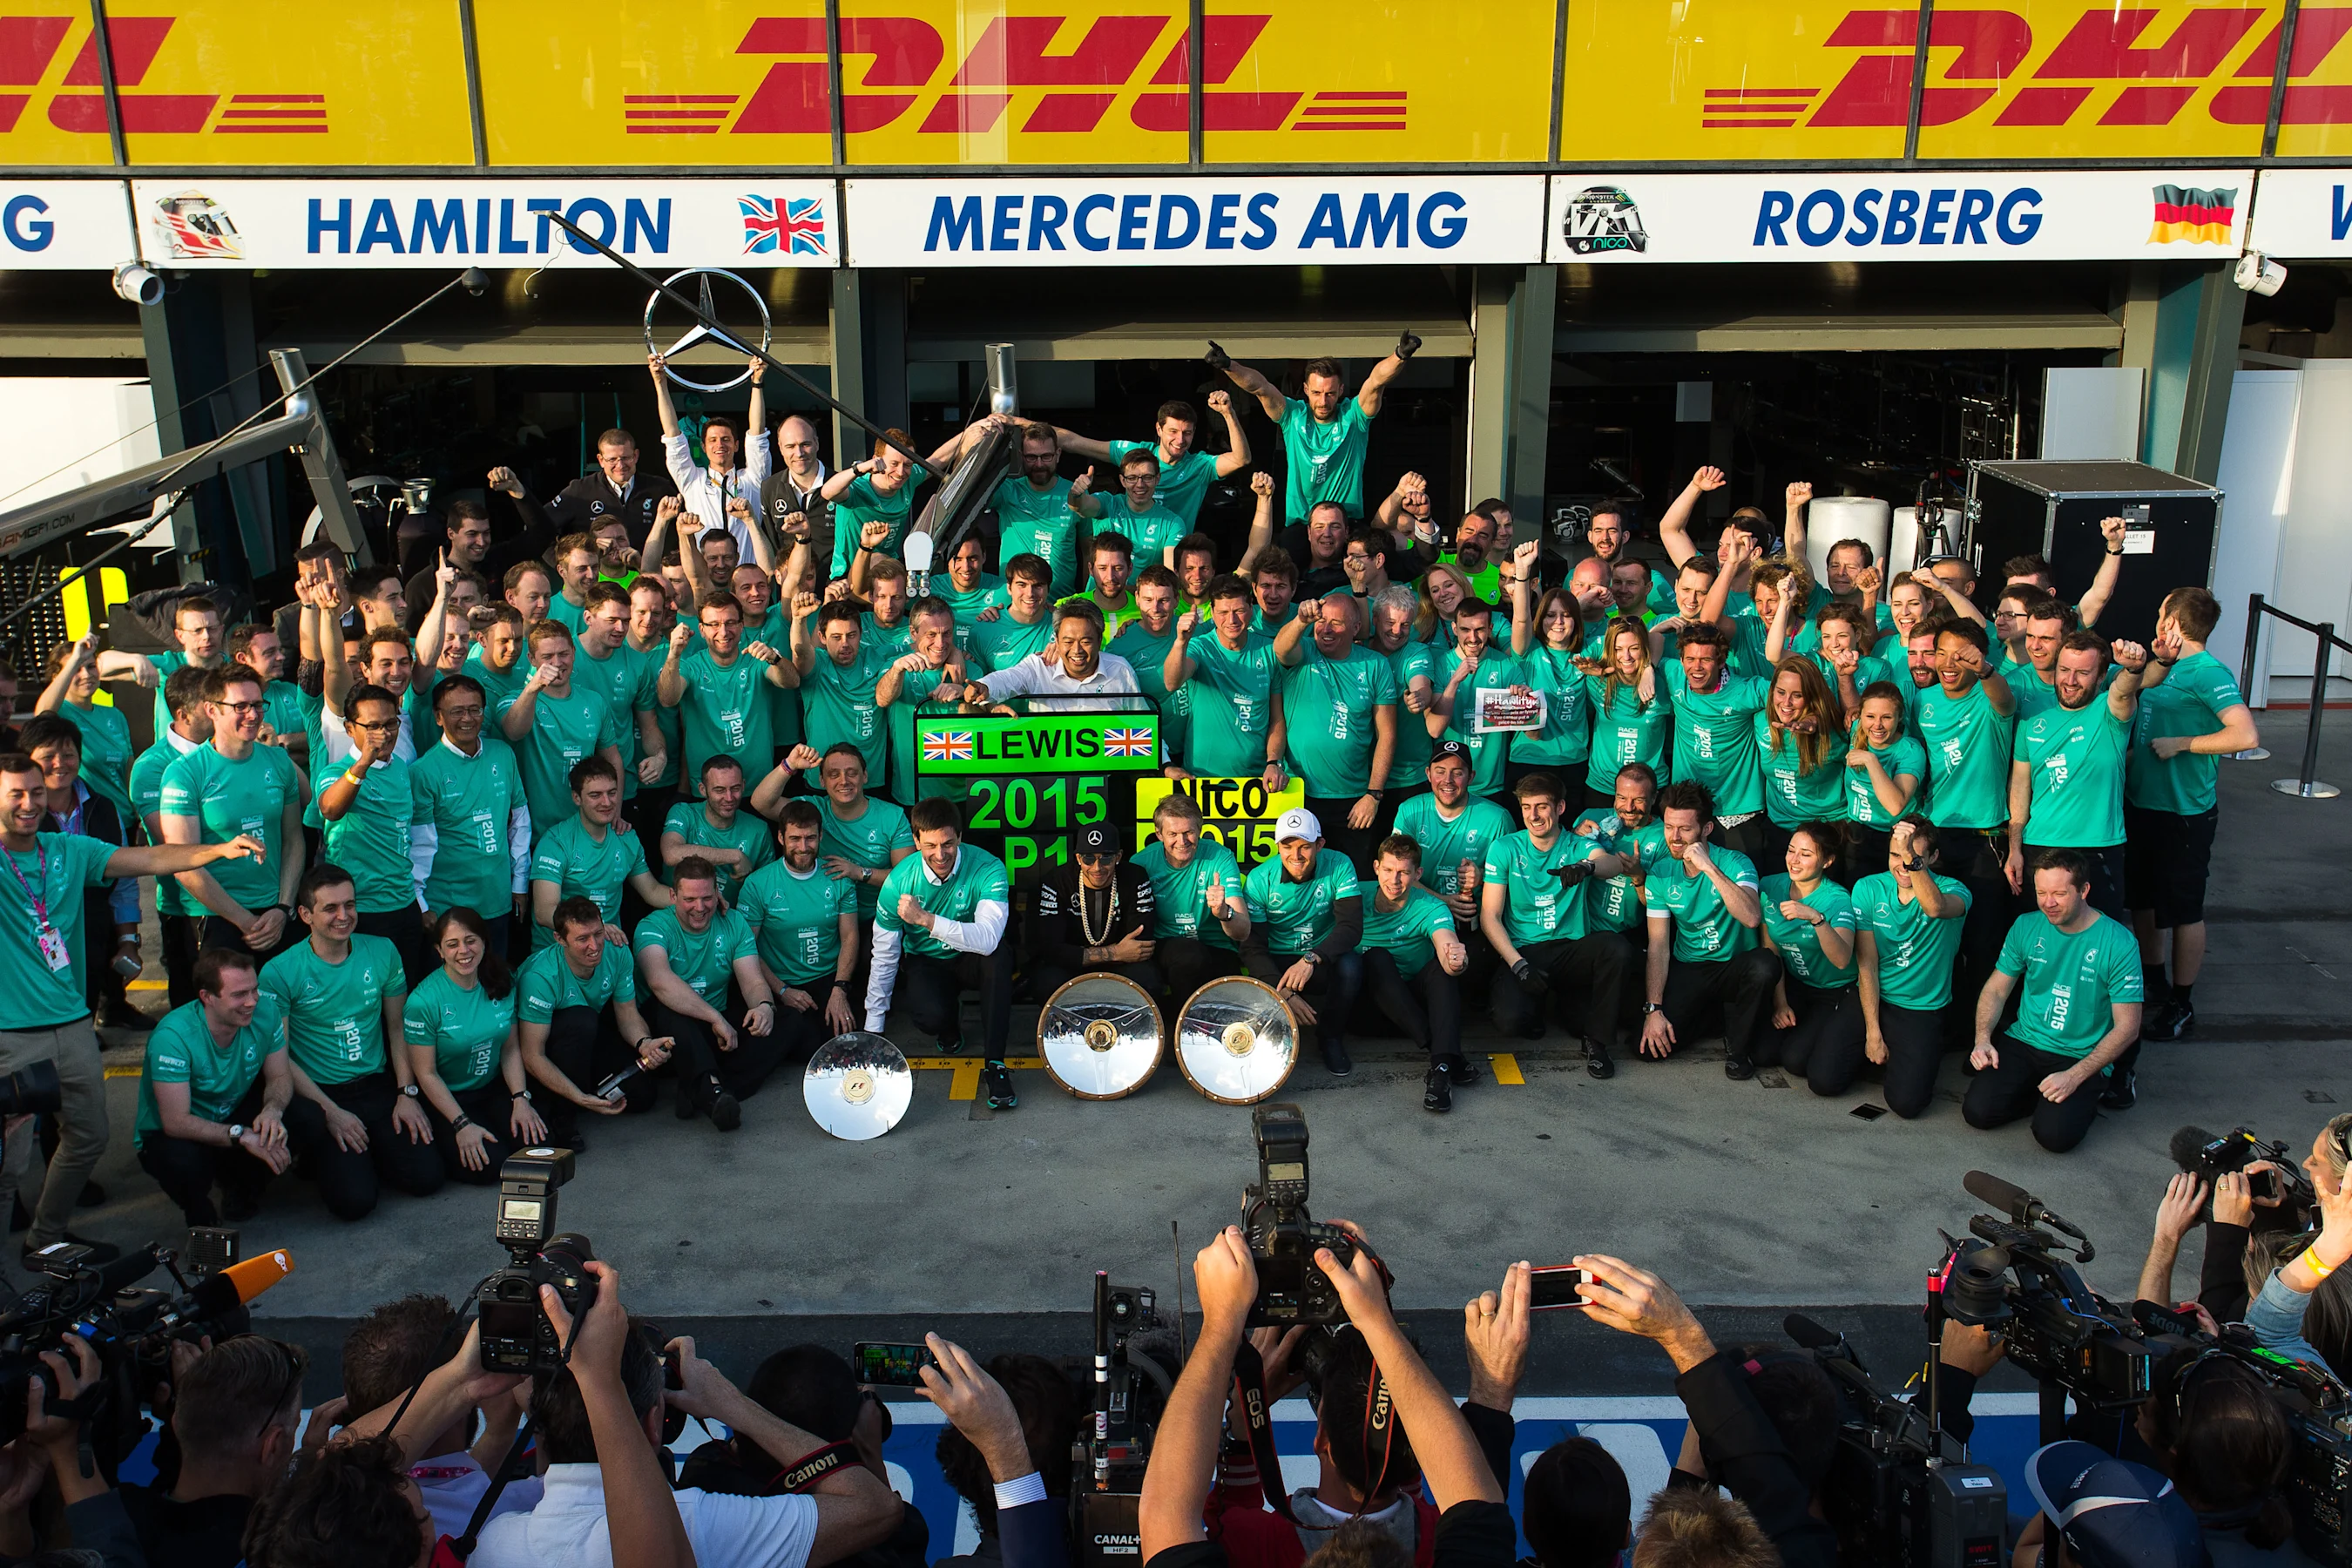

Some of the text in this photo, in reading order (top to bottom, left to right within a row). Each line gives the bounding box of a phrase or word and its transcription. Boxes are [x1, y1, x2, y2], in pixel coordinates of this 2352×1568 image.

[729, 15, 1305, 133] DHL
[308, 197, 672, 255] HAMILTON
[924, 191, 1469, 252] MERCEDES AMG
[1754, 187, 2043, 247] ROSBERG
[1592, 237, 1628, 249] nico
[1176, 689, 1191, 717] 2015
[1560, 696, 1575, 721] 2015
[729, 718, 745, 747] 2015
[862, 710, 874, 737] 2015
[1239, 705, 1252, 733] 2015
[1334, 711, 1348, 740] 2015
[977, 728, 1100, 760] LEWIS
[1699, 731, 1713, 759] 2015
[1940, 737, 1960, 747] RACE
[2044, 753, 2065, 763] RACE
[473, 808, 491, 816] RACE
[969, 776, 1108, 828] 2015
[1858, 794, 1872, 822] 2015
[241, 815, 264, 825] RACE
[482, 821, 497, 854] 2015
[1005, 835, 1069, 887] P1
[1544, 903, 1556, 929] 2015
[1607, 887, 1624, 917] 2015
[807, 937, 819, 965] 2015
[1705, 926, 1721, 952] 2015
[1791, 951, 1809, 977] 2015
[2050, 996, 2070, 1031] 2015
[346, 1027, 362, 1062] 2015
[474, 1049, 491, 1076] 2015
[1247, 1388, 1266, 1429] EOS
[784, 1452, 839, 1489] Canon
[1093, 1534, 1141, 1545] CANAL+
